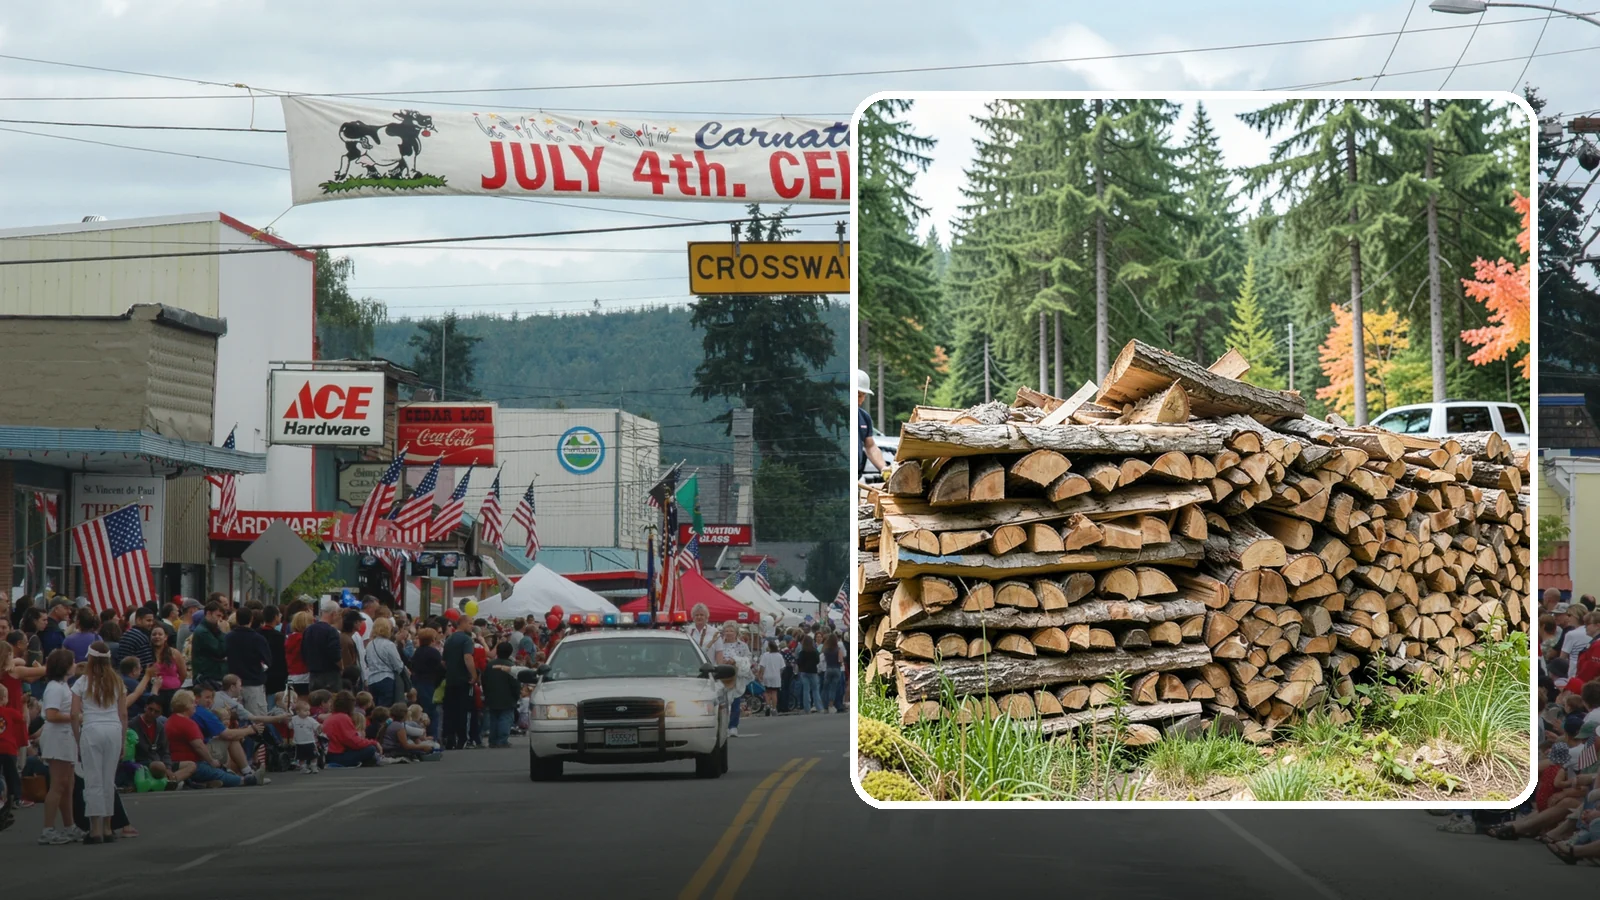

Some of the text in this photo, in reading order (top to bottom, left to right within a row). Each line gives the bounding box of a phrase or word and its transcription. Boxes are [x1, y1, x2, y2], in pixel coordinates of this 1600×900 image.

[481, 141, 605, 192] JULY
[632, 150, 746, 198] 4th.
[697, 254, 850, 280] CROSSWA
[283, 380, 373, 420] ACE
[405, 409, 453, 422] CEDAR
[283, 421, 371, 436] Hardware
[416, 428, 476, 447] Coca-Cola
[353, 467, 386, 481] Simpl
[95, 485, 124, 494] Vincent
[126, 486, 136, 495] de
[138, 486, 155, 495] Paul
[688, 526, 741, 535] CRNATION
[699, 535, 730, 543] GLASS
